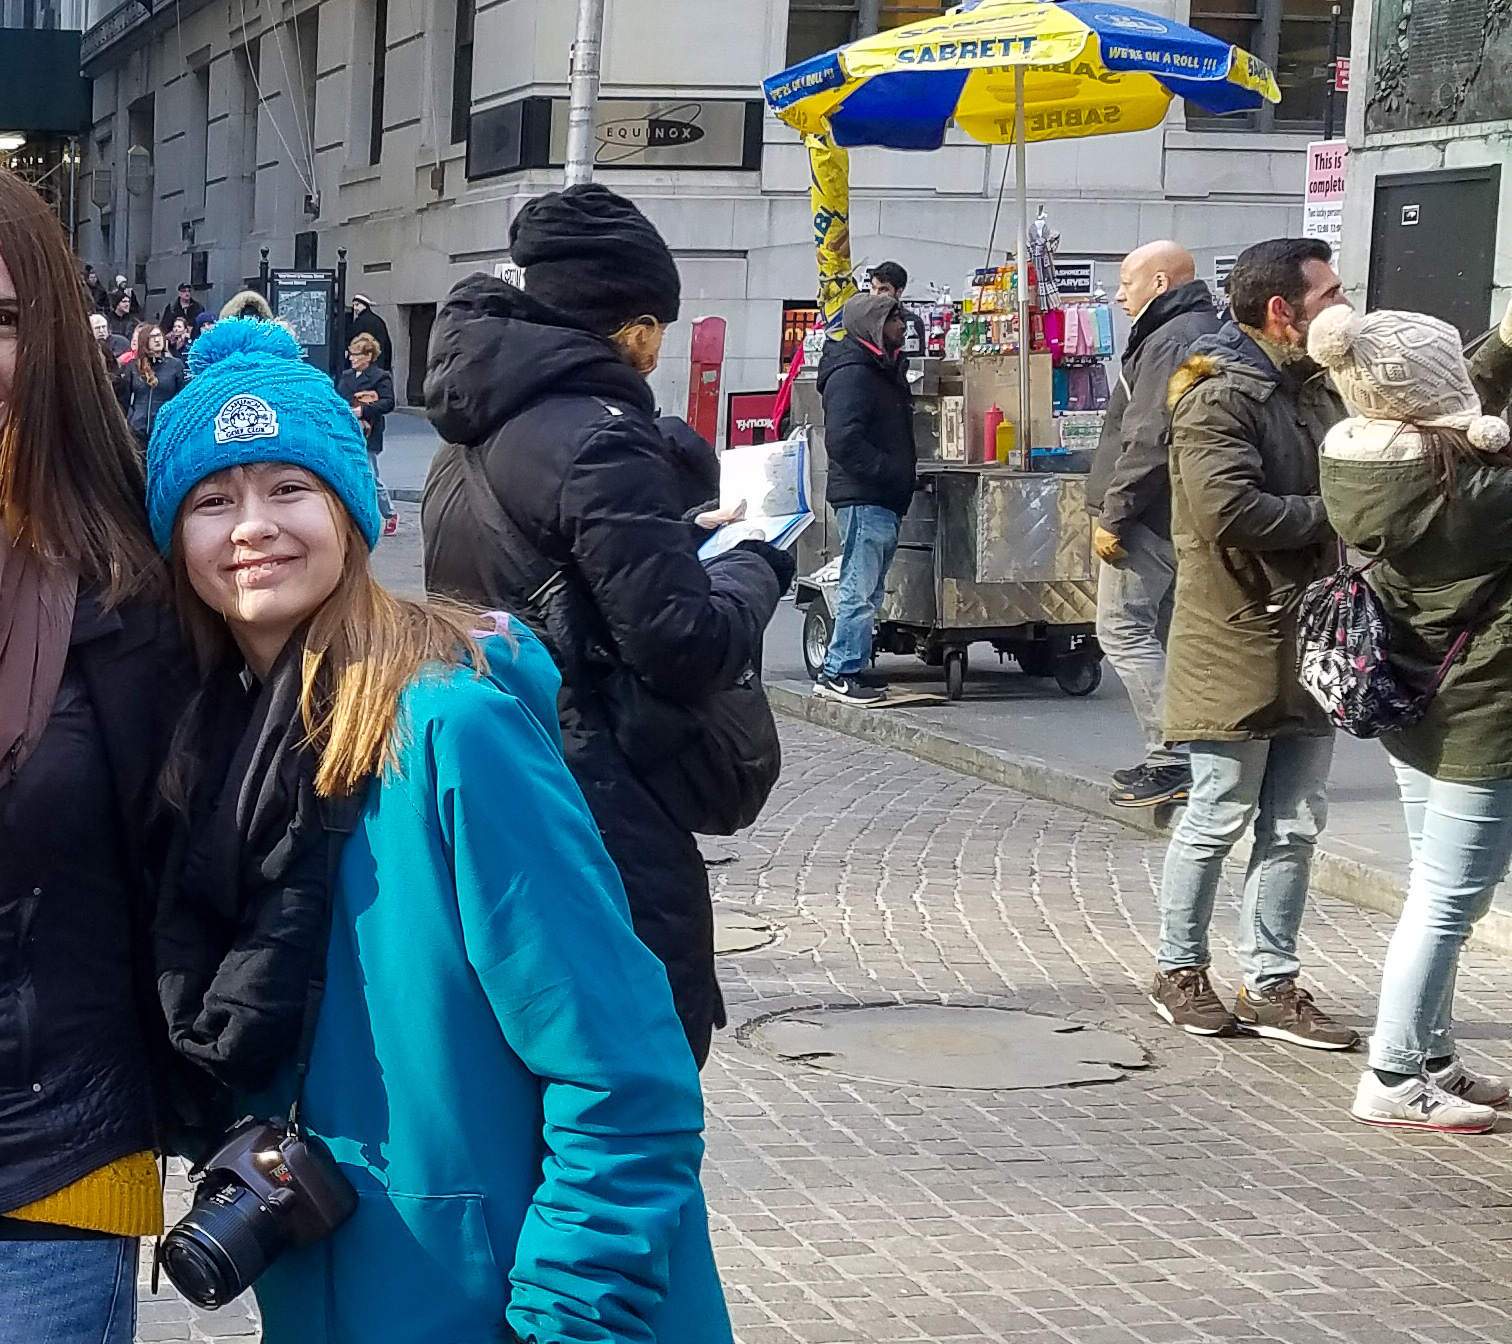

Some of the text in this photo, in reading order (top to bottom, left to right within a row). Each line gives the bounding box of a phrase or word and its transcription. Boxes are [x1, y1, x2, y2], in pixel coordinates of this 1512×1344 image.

[898, 35, 1038, 64] SABRETT
[1162, 52, 1173, 65] A
[1174, 54, 1200, 69] ROLL
[606, 127, 692, 139] EQUINOX
[1314, 150, 1342, 171] This is
[1054, 278, 1090, 287] CARVES
